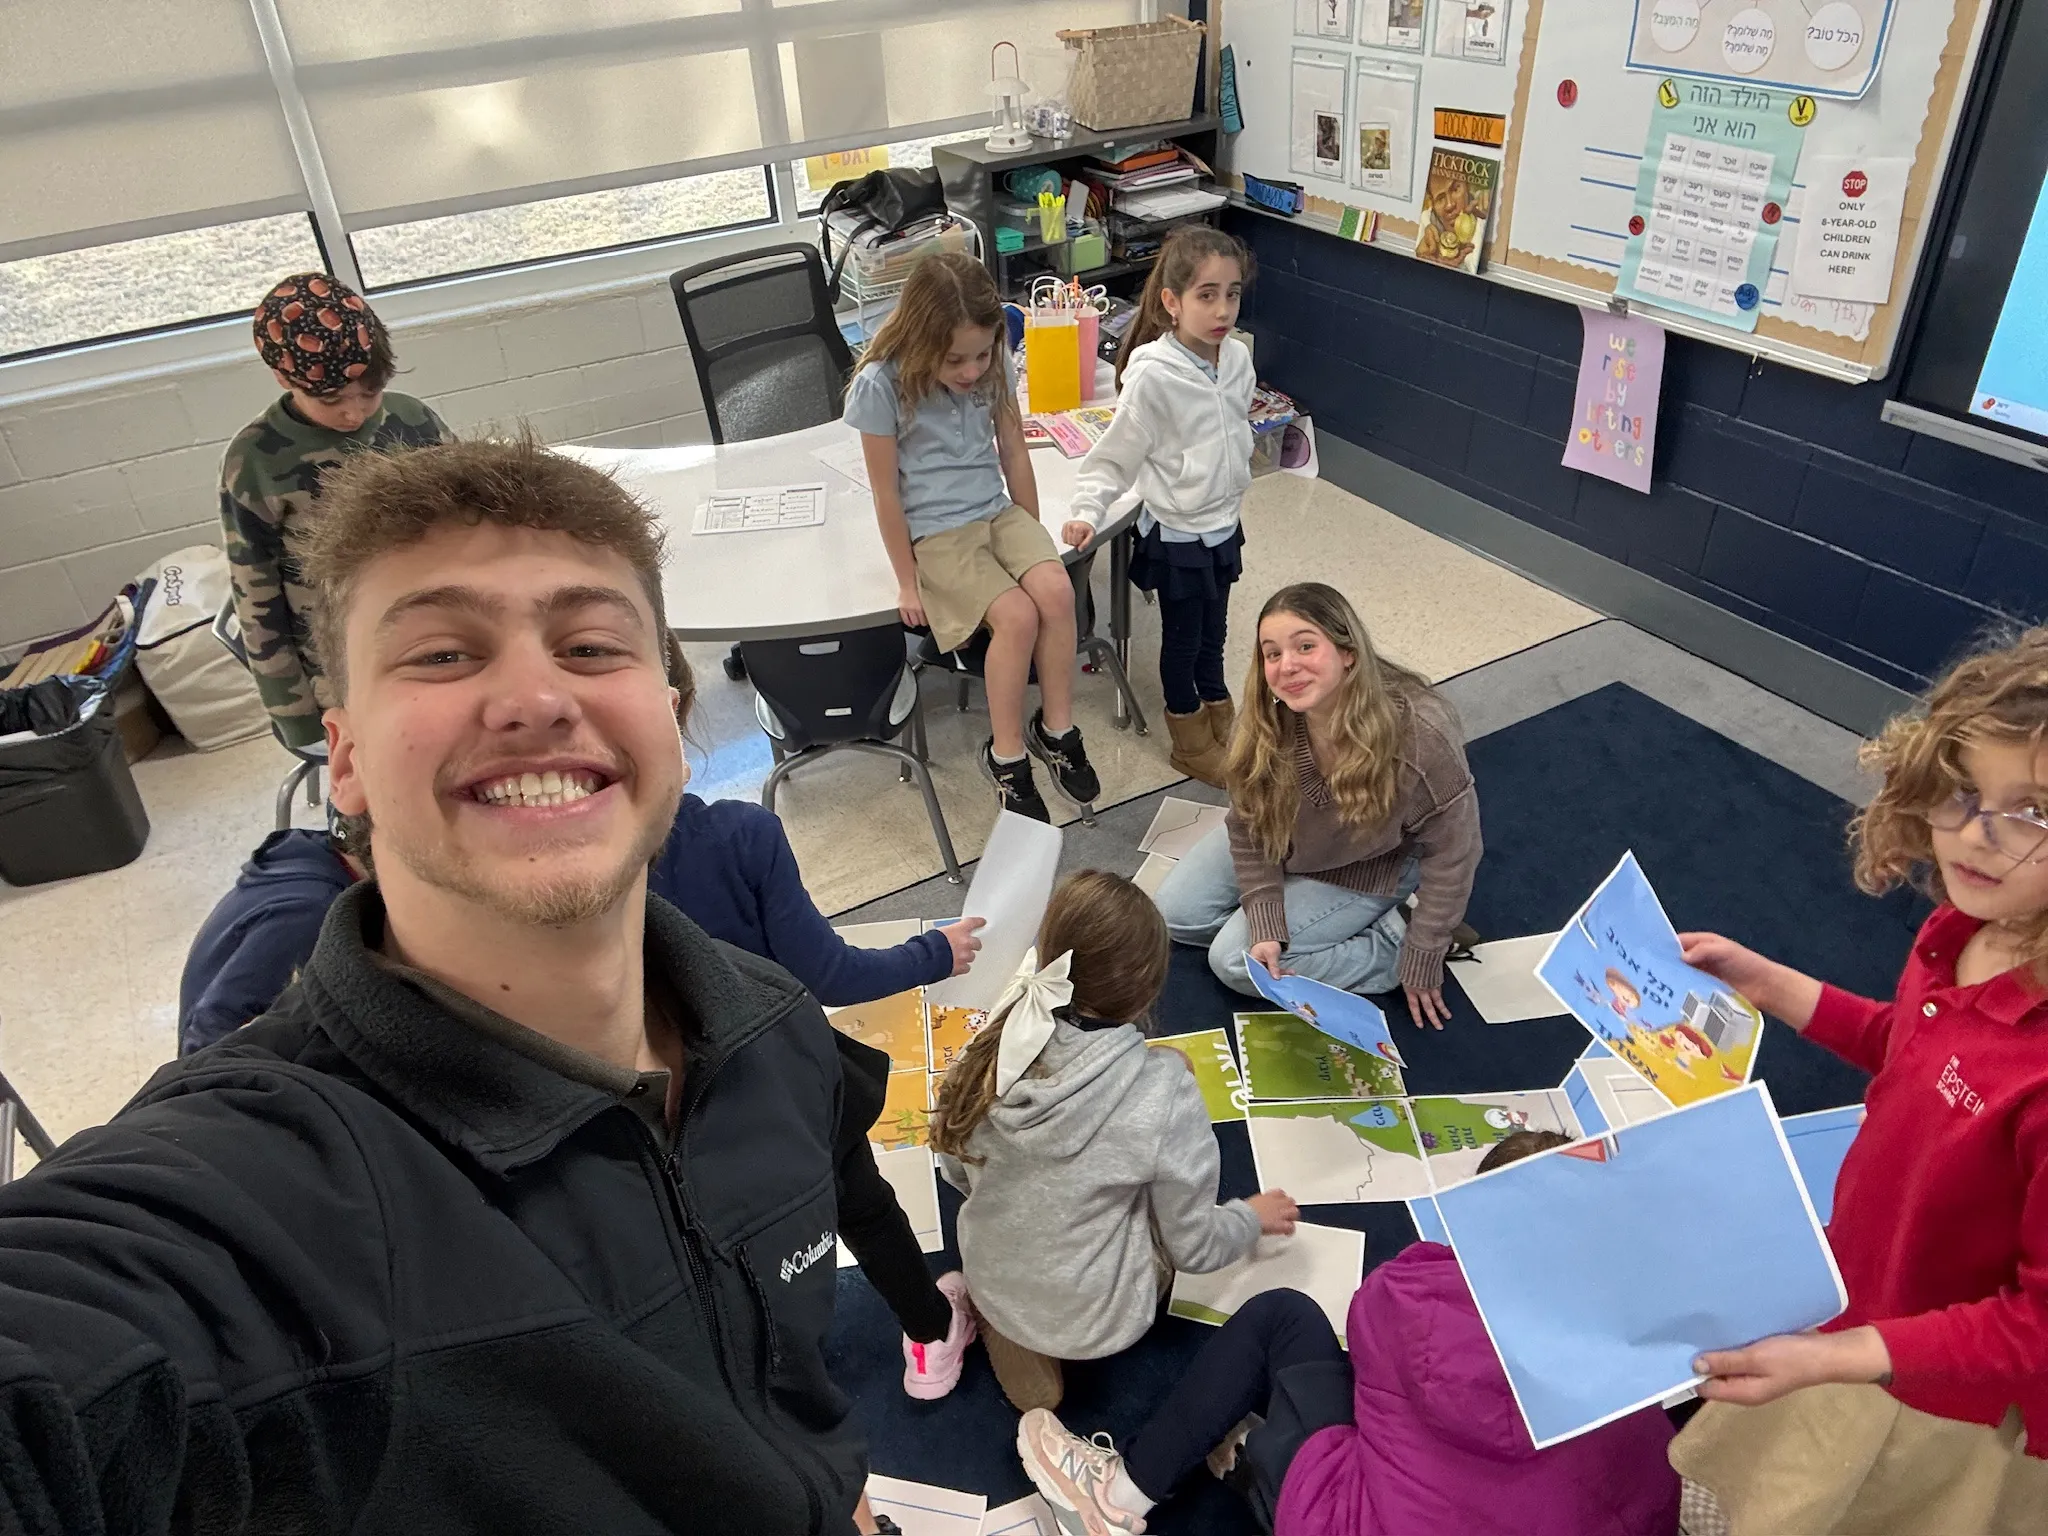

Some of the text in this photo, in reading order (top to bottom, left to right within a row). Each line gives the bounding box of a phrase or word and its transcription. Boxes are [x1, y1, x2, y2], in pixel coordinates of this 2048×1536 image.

[1690, 84, 1771, 110] הילד הזה
[1443, 113, 1494, 141] FOCUS BOOK
[1693, 115, 1757, 139] הוא אני
[1434, 152, 1491, 178] TICKTOCK
[1843, 178, 1868, 190] STOP
[1839, 202, 1865, 211] ONLY
[1821, 218, 1877, 229] 8-YEAR-OLD
[1823, 233, 1871, 244] CHILDREN
[1820, 249, 1872, 261] CAN DRINK
[1828, 264, 1856, 275] HERE!
[1608, 333, 1637, 357] we
[1605, 378, 1628, 407] by
